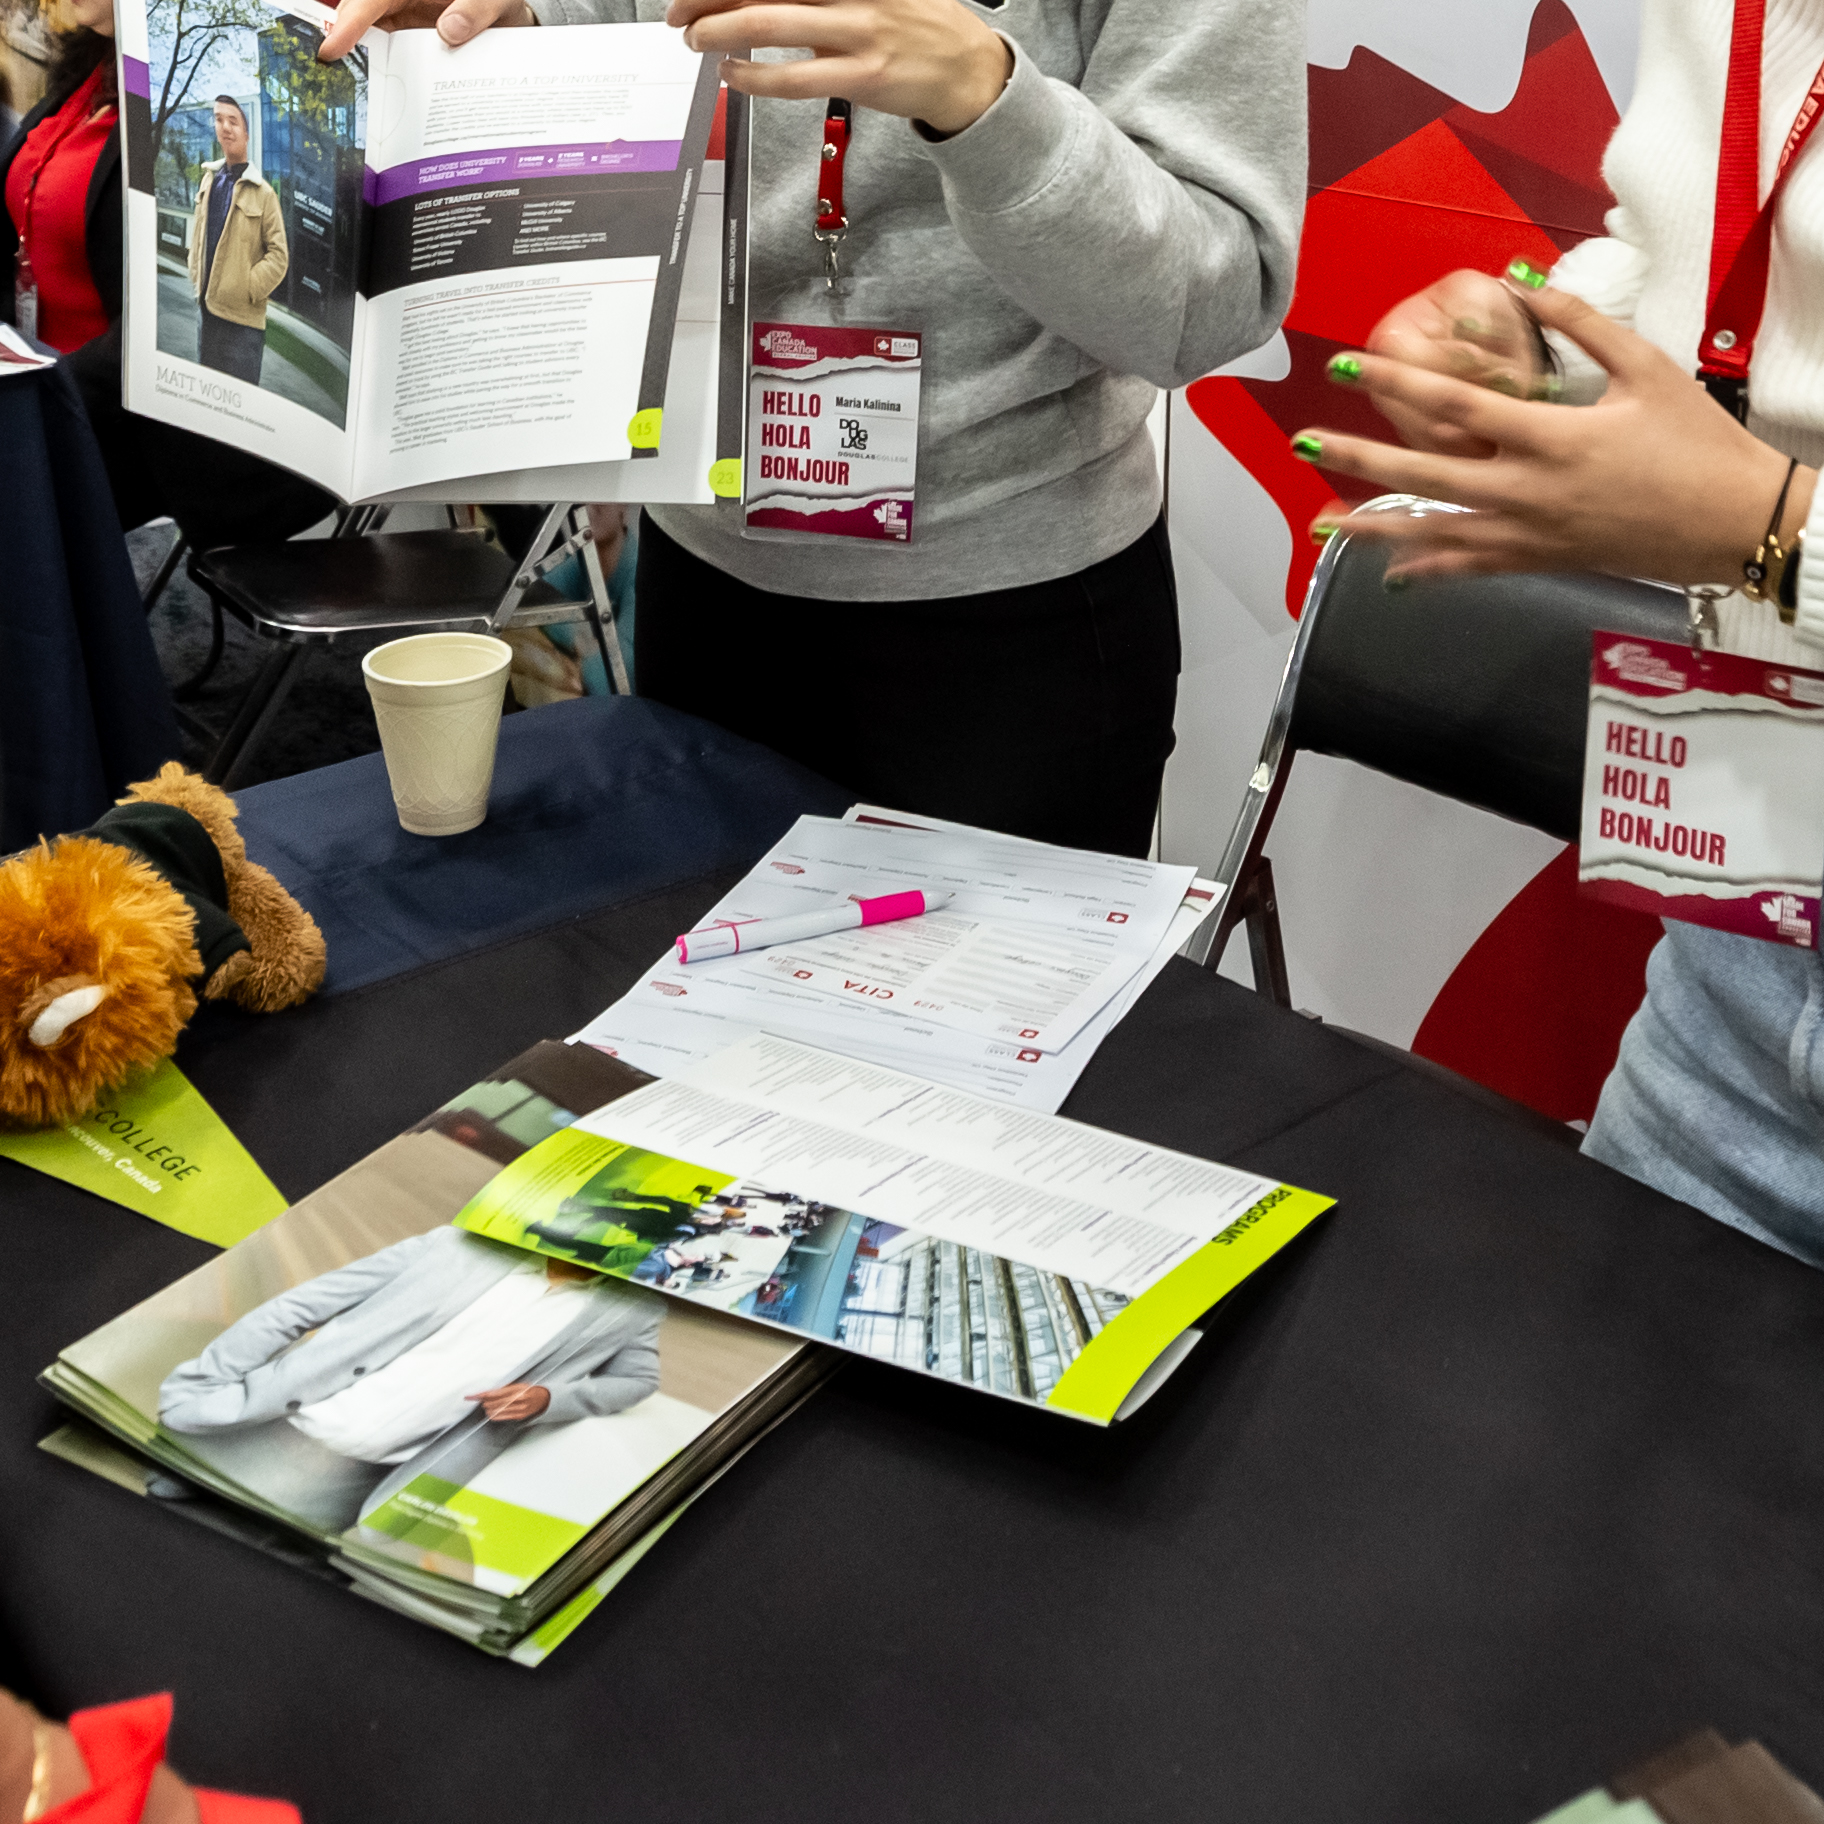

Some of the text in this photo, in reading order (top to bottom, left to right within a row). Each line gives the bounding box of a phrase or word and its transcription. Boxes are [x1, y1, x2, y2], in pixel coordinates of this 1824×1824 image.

[433, 78, 496, 91] TRANSFER
[500, 77, 517, 87] TO
[534, 75, 558, 85] TOP
[561, 74, 639, 85] UNIVERSITY
[418, 167, 484, 185] TRANSFER WORK?
[419, 156, 507, 176] HOW DOES UNIVERSITY
[415, 188, 520, 211] LOTS OF TRANSFER OPTIONS
[436, 288, 463, 299] TRAVEL
[464, 285, 484, 295] INTO
[485, 280, 524, 292] TRANSFER
[526, 276, 560, 287] CREDITS
[772, 338, 806, 347] CANADA
[772, 345, 817, 355] EDUCATION
[894, 341, 916, 349] CLASS
[156, 365, 242, 408] MATT WONG
[762, 390, 821, 418] HELLO
[836, 396, 901, 412] Maria Kalinina
[637, 422, 652, 437] 15
[761, 423, 811, 450] HOLA
[717, 471, 734, 485] 23
[760, 455, 850, 486] BONJOUR
[1605, 721, 1688, 768] HELLO
[1602, 764, 1671, 811] HOLA
[1599, 807, 1726, 867] BONJOUR
[1080, 911, 1106, 920] CLASS
[843, 980, 894, 1000] CITA
[95, 1110, 201, 1181] COLLEGE
[69, 1125, 162, 1194] ncouver, Canada
[1211, 1189, 1293, 1246] PROGRAMS
